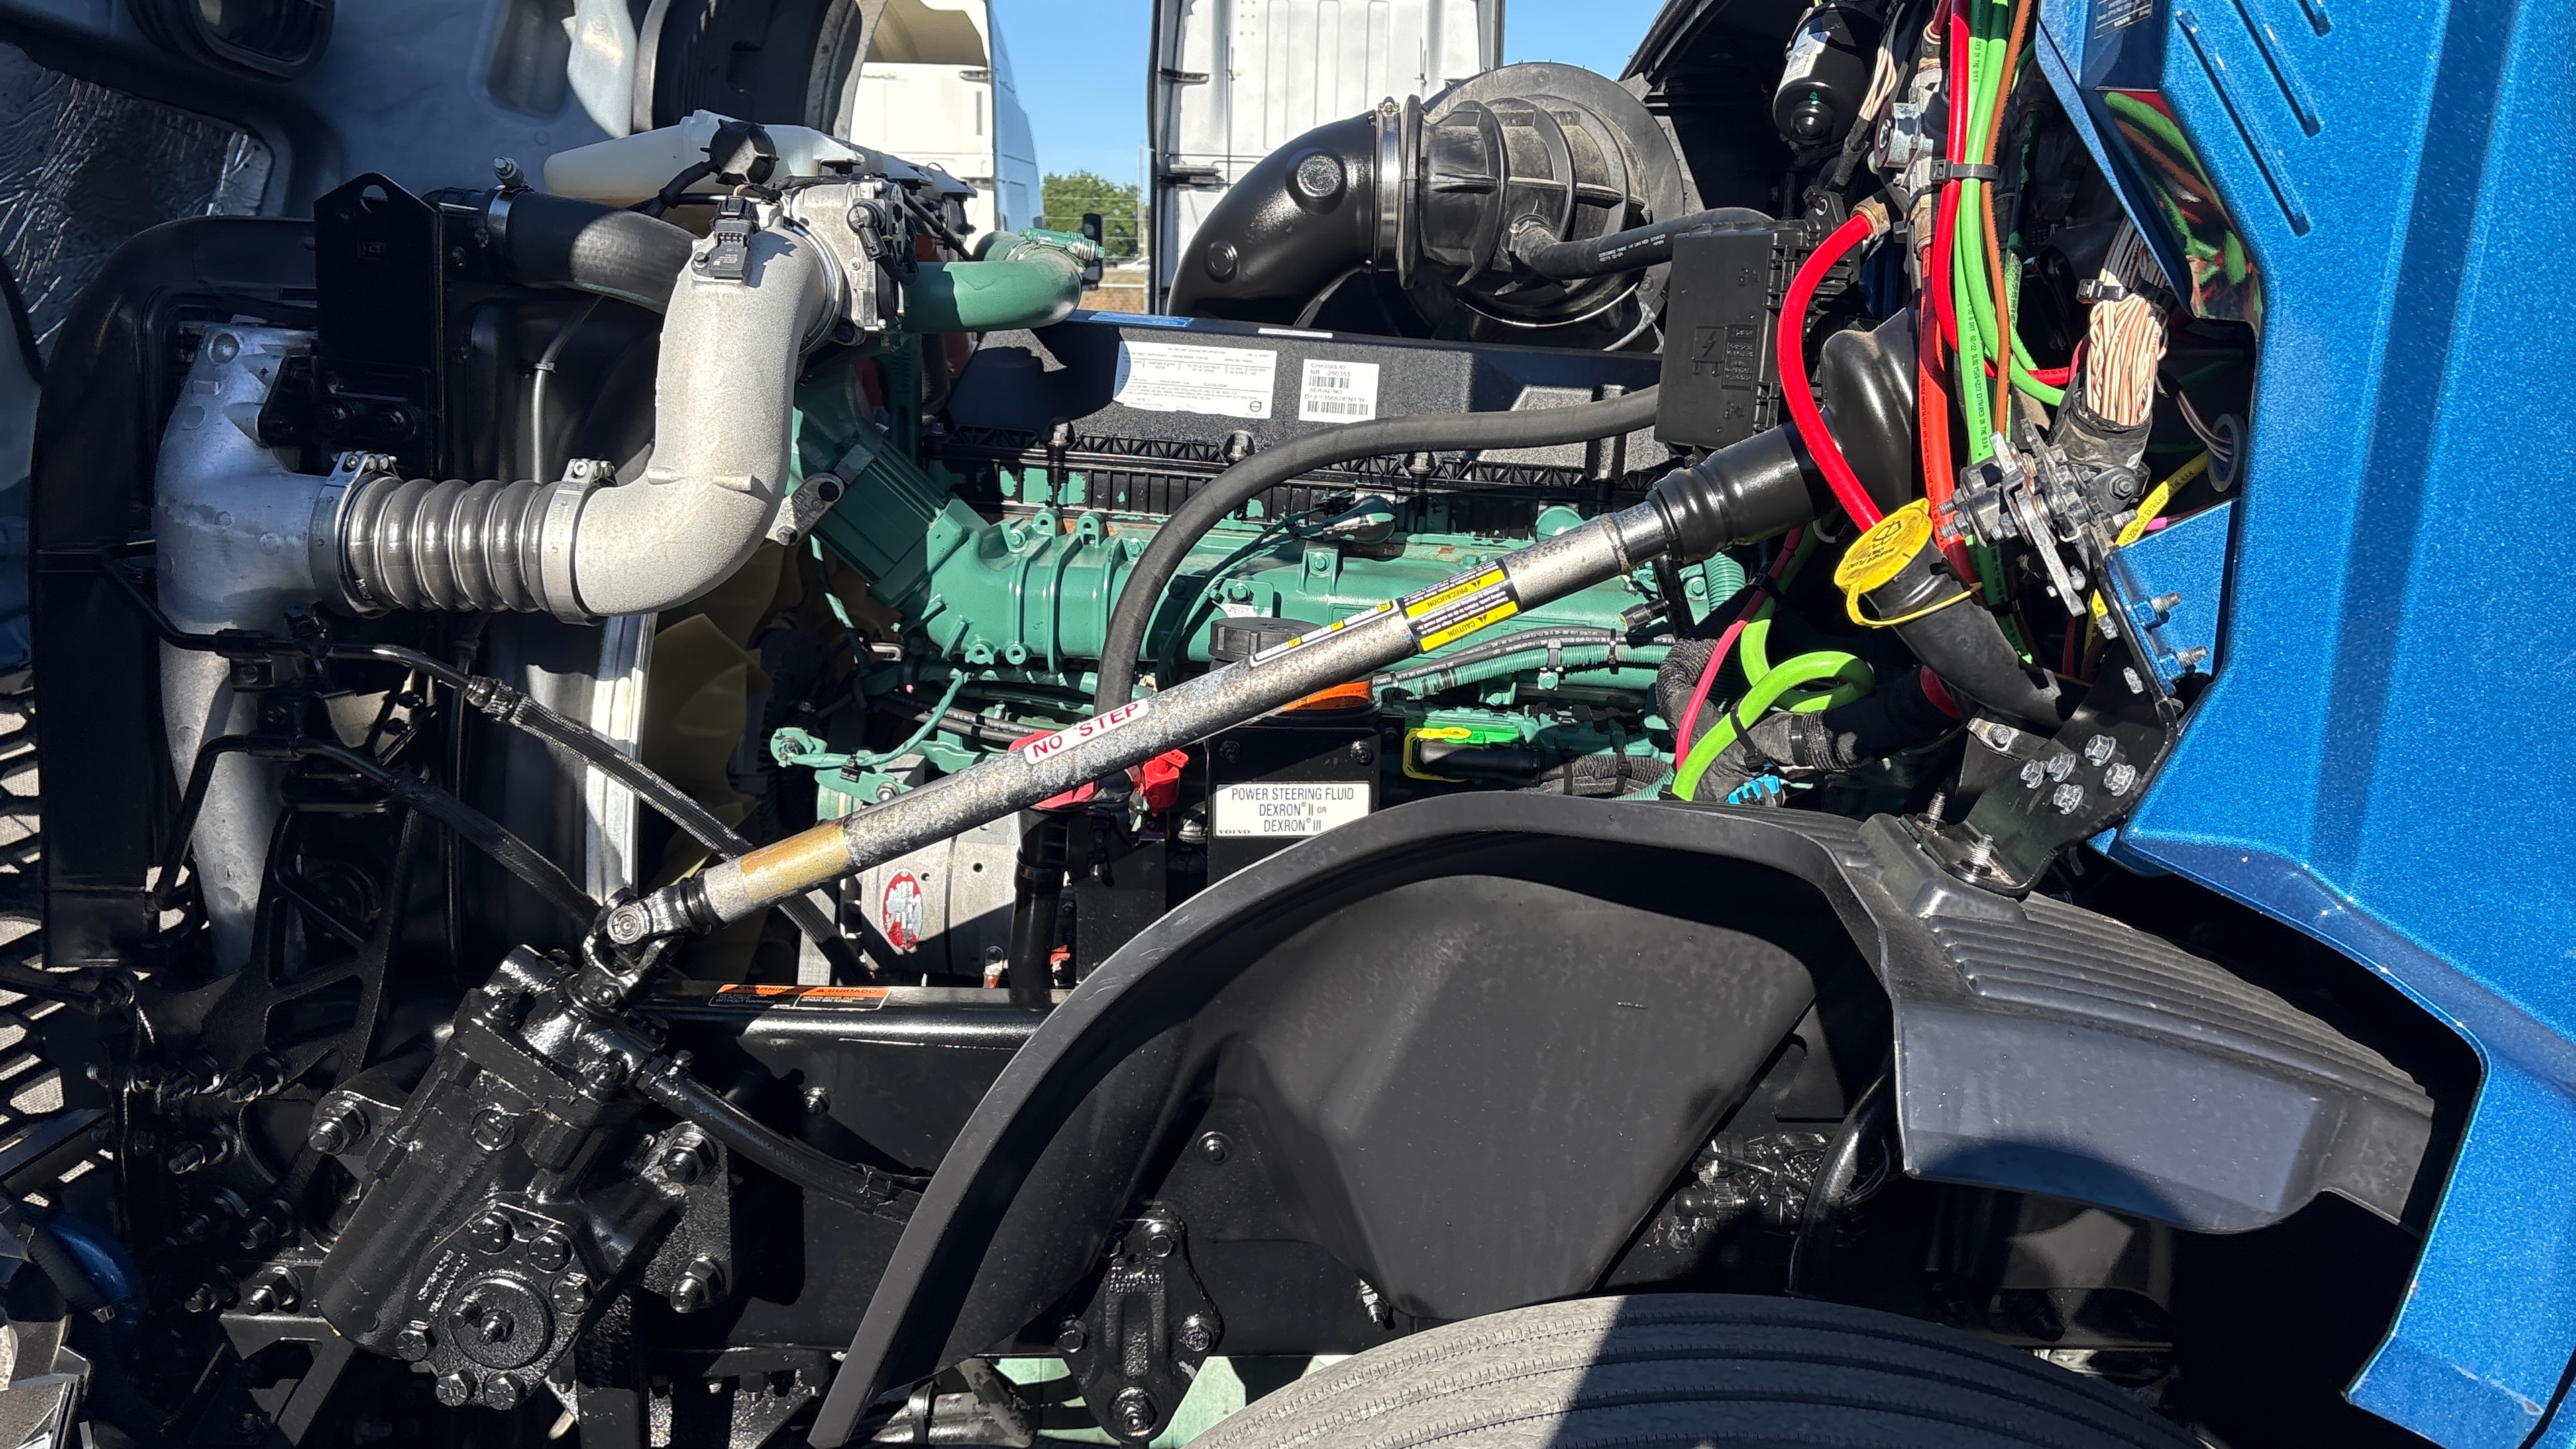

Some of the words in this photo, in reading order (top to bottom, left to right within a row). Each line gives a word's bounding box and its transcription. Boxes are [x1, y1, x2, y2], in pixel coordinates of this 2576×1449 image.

[1426, 586, 1468, 607] PRECAUCION
[1446, 620, 1476, 637] CAUTION
[1033, 735, 1062, 757] NO
[1079, 703, 1138, 737] STEP
[1232, 788, 1269, 800] POWER
[1272, 788, 1322, 800] STEERING
[1326, 788, 1354, 800] FLUID
[1259, 802, 1307, 816] DEXRON®
[1308, 804, 1313, 816] II
[1264, 818, 1311, 833] DEXRON®
[1313, 820, 1321, 832] III
